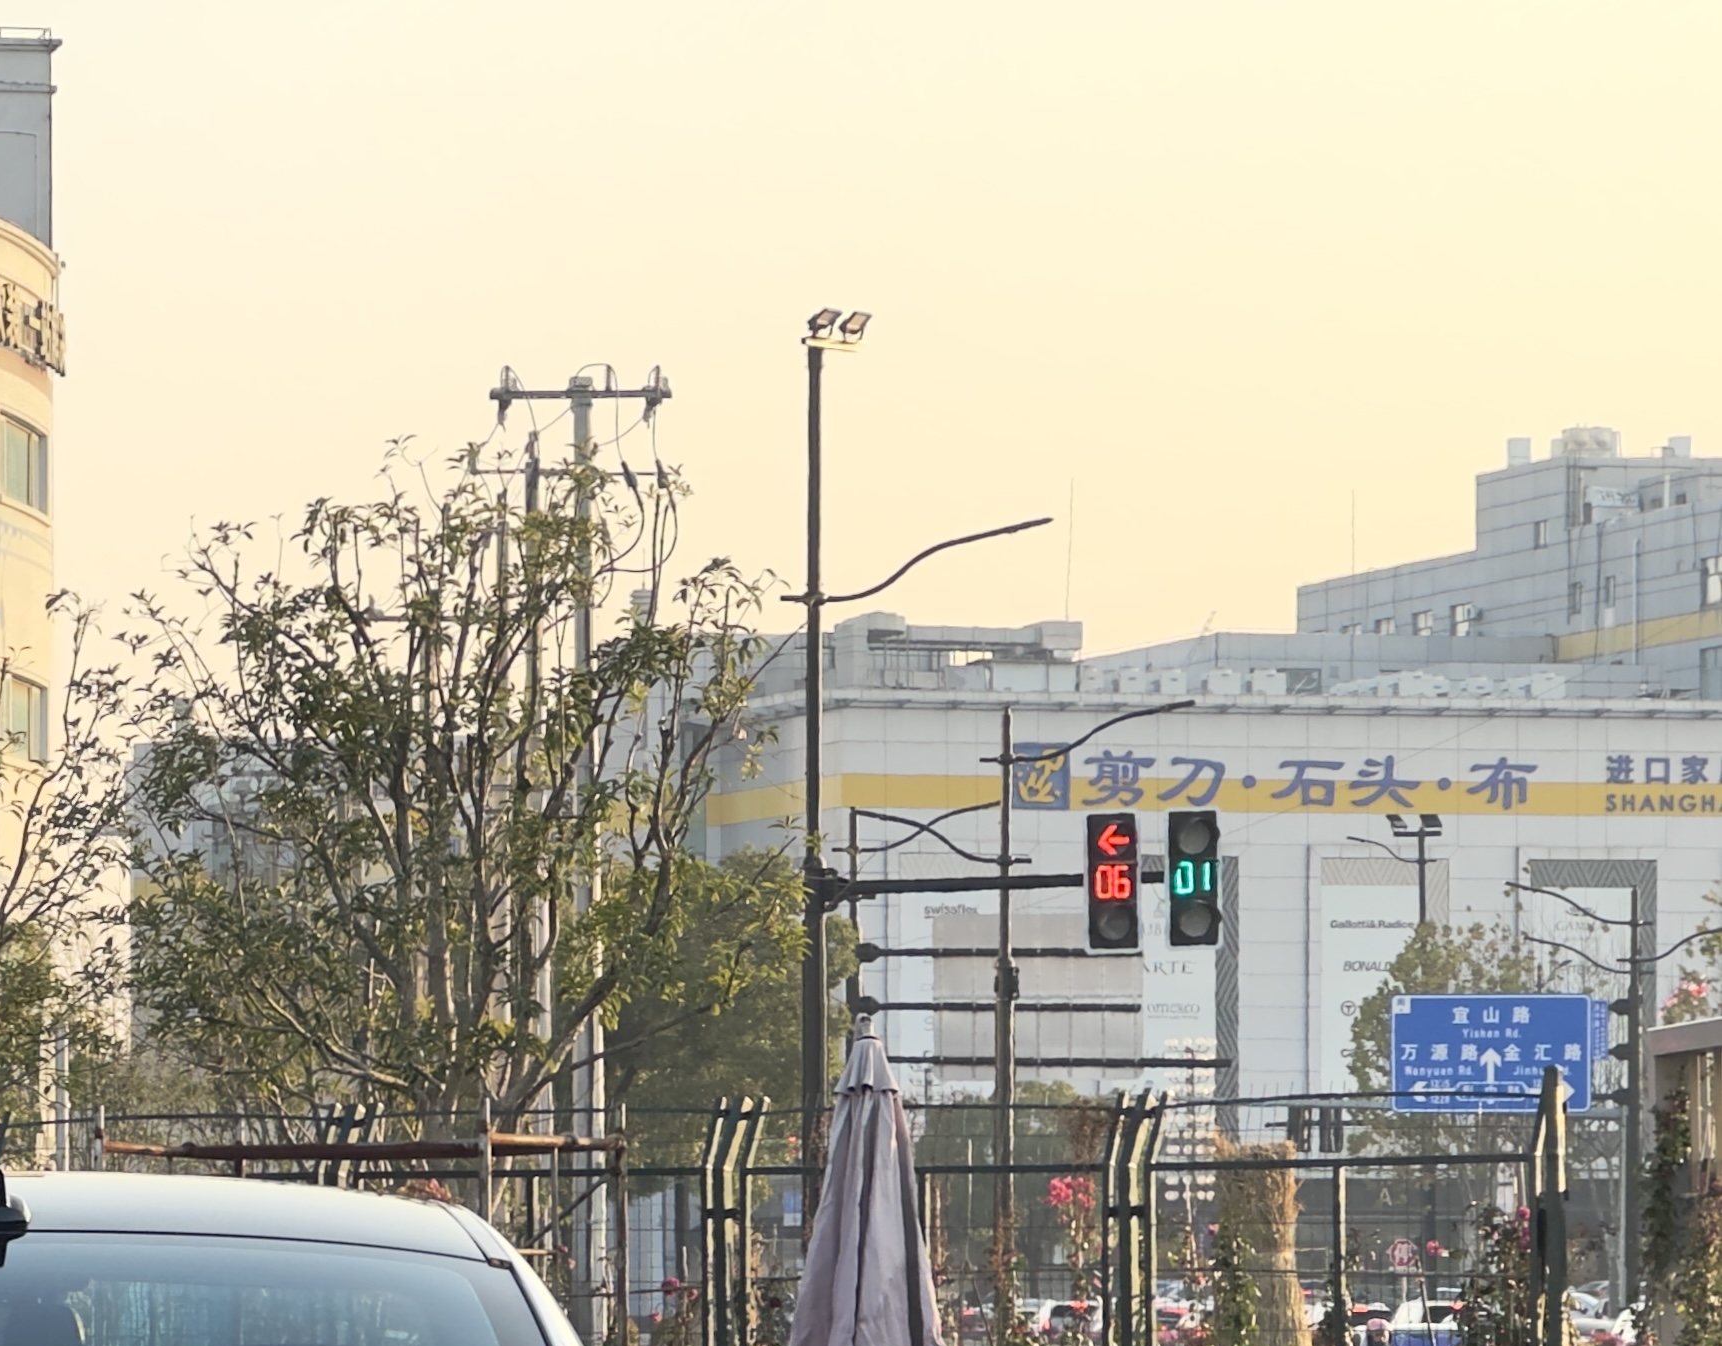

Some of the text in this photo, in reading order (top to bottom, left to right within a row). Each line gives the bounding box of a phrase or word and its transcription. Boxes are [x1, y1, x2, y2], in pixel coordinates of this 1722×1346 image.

[1605, 754, 1722, 785] 进口家
[1095, 864, 1131, 899] 06
[1173, 861, 1211, 894] 01
[1343, 960, 1391, 971] BONALD
[1452, 1006, 1531, 1024] 宜山路
[1400, 1043, 1478, 1061] 万源路
[1503, 1043, 1582, 1061] 金汇路
[1513, 1065, 1545, 1076] Jinhu
